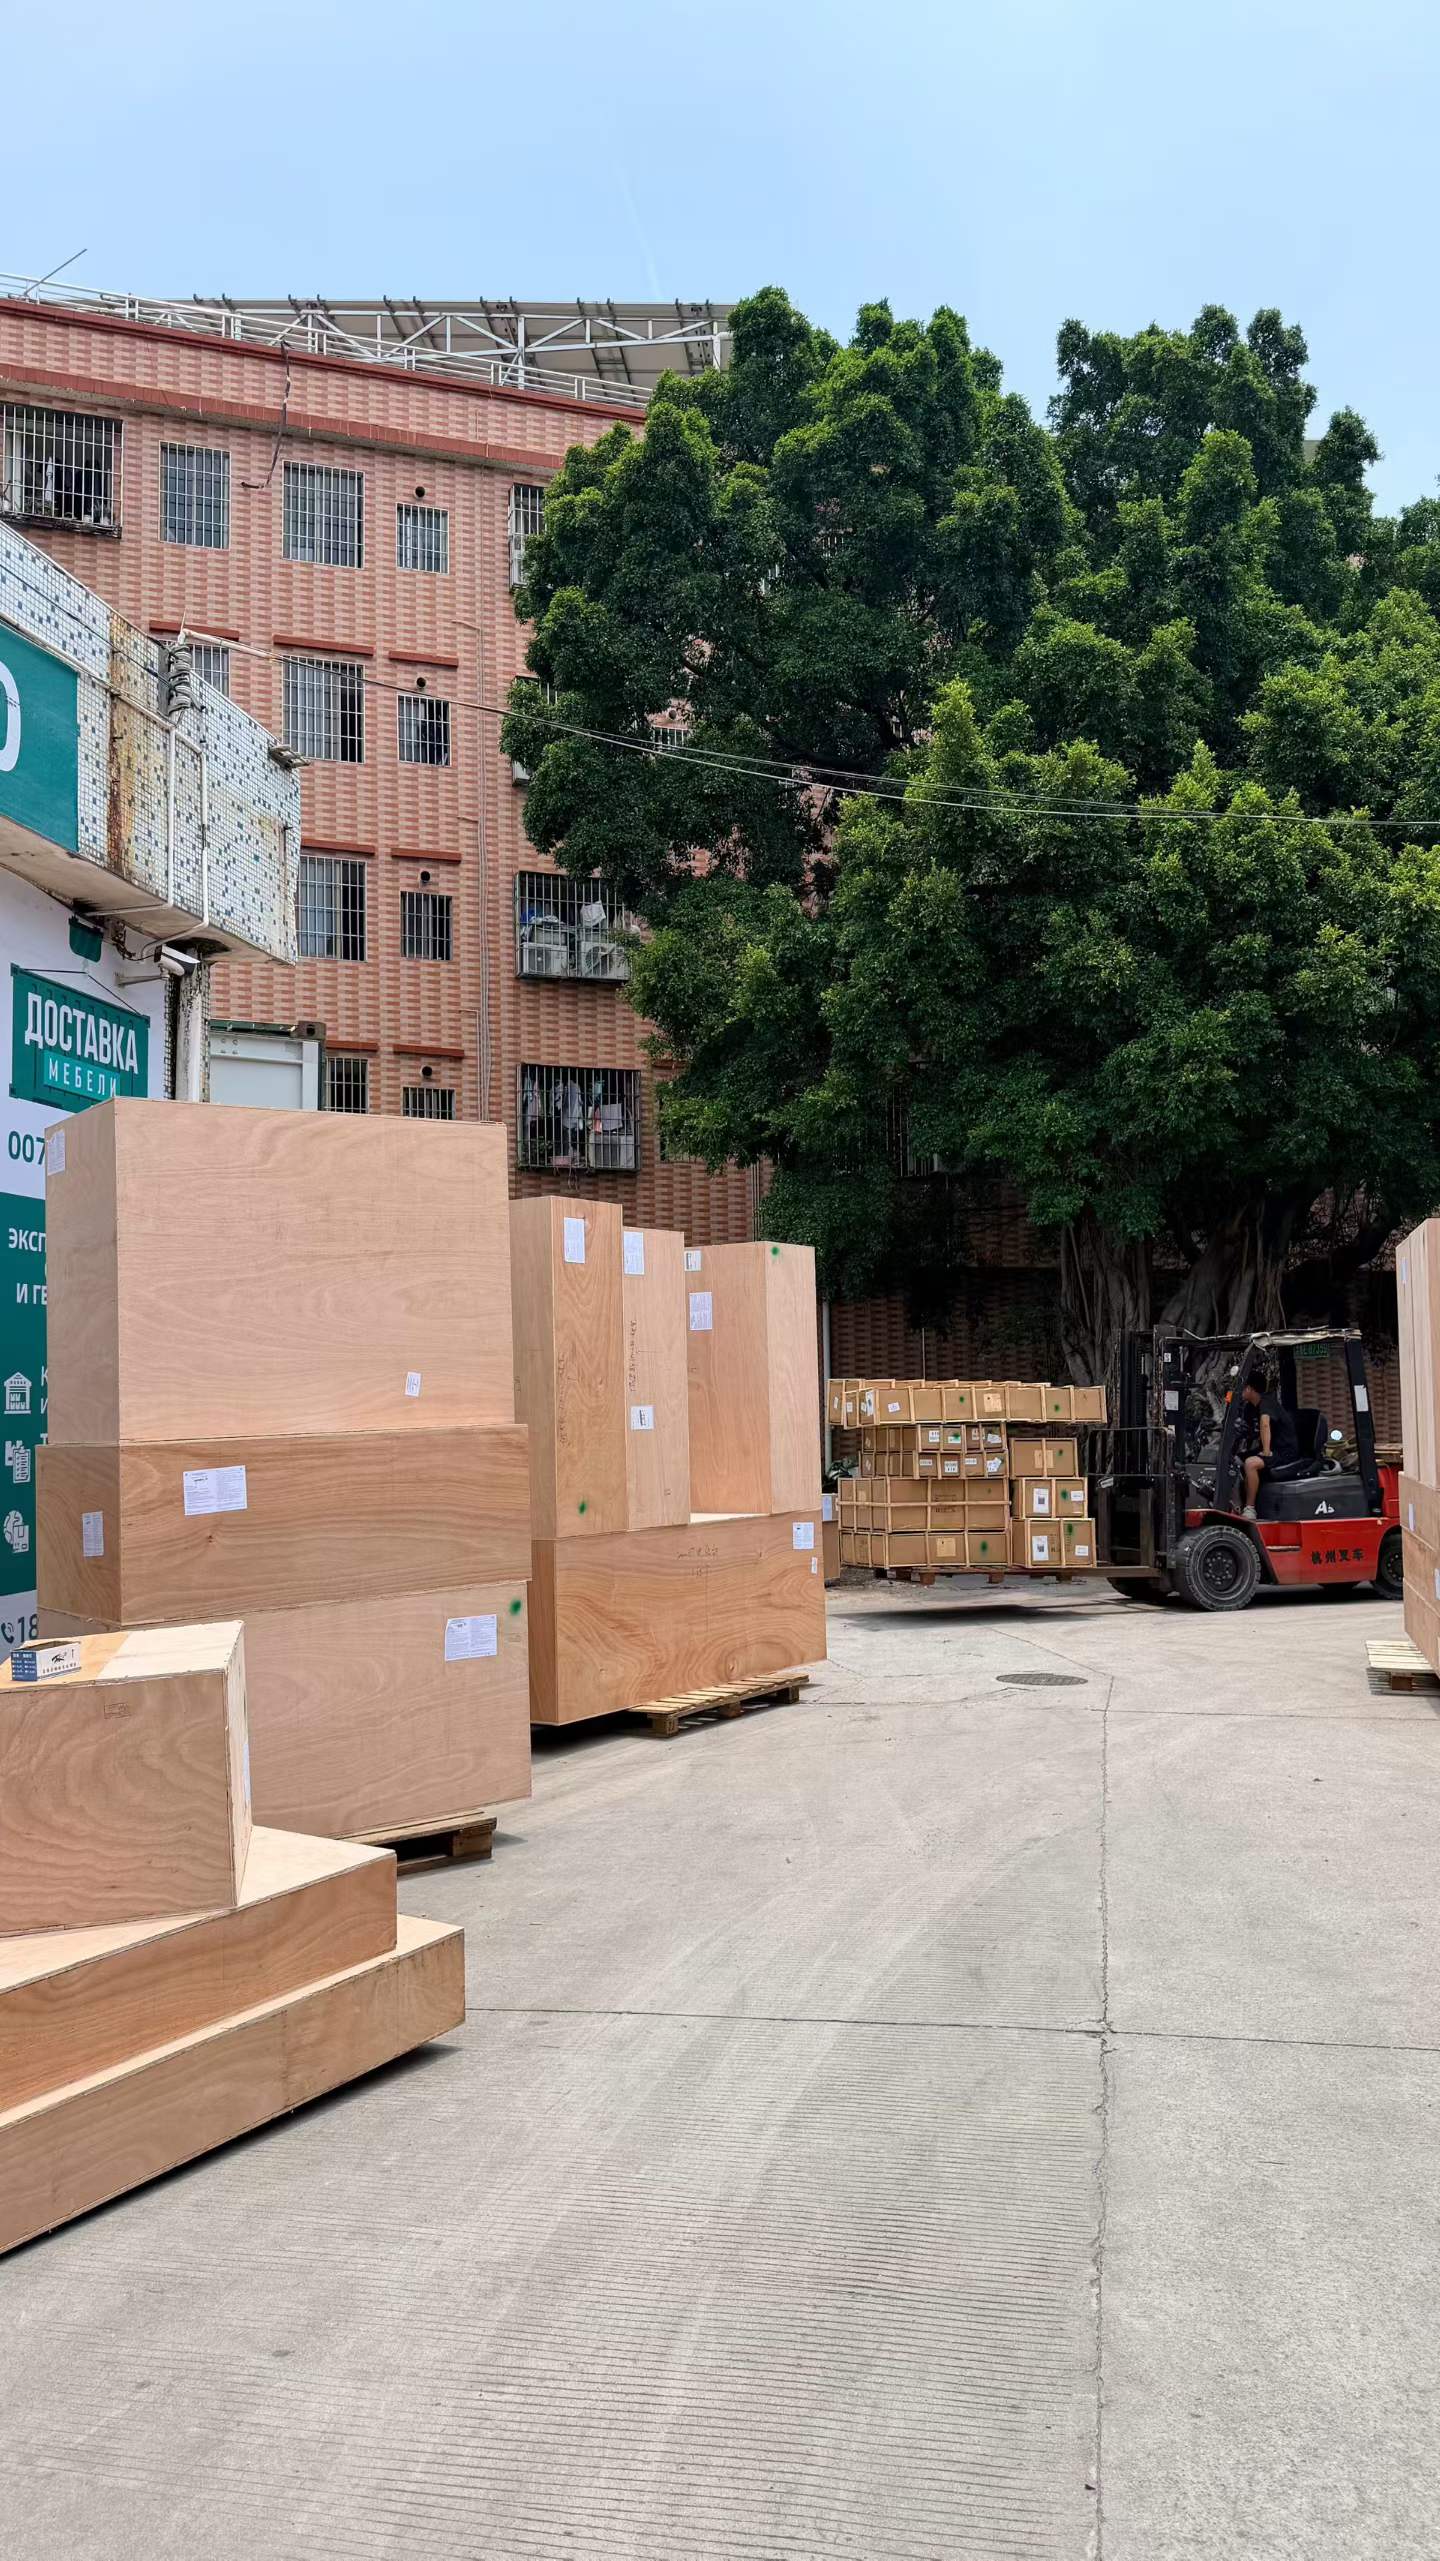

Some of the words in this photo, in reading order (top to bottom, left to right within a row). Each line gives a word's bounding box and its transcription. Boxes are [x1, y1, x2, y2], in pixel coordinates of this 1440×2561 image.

[25, 992, 138, 1074] ДОСТАВКА
[49, 1058, 117, 1097] МЕБЕЛИ
[8, 1131, 46, 1165] 007
[16, 1283, 28, 1304] И
[18, 1613, 39, 1642] 18
